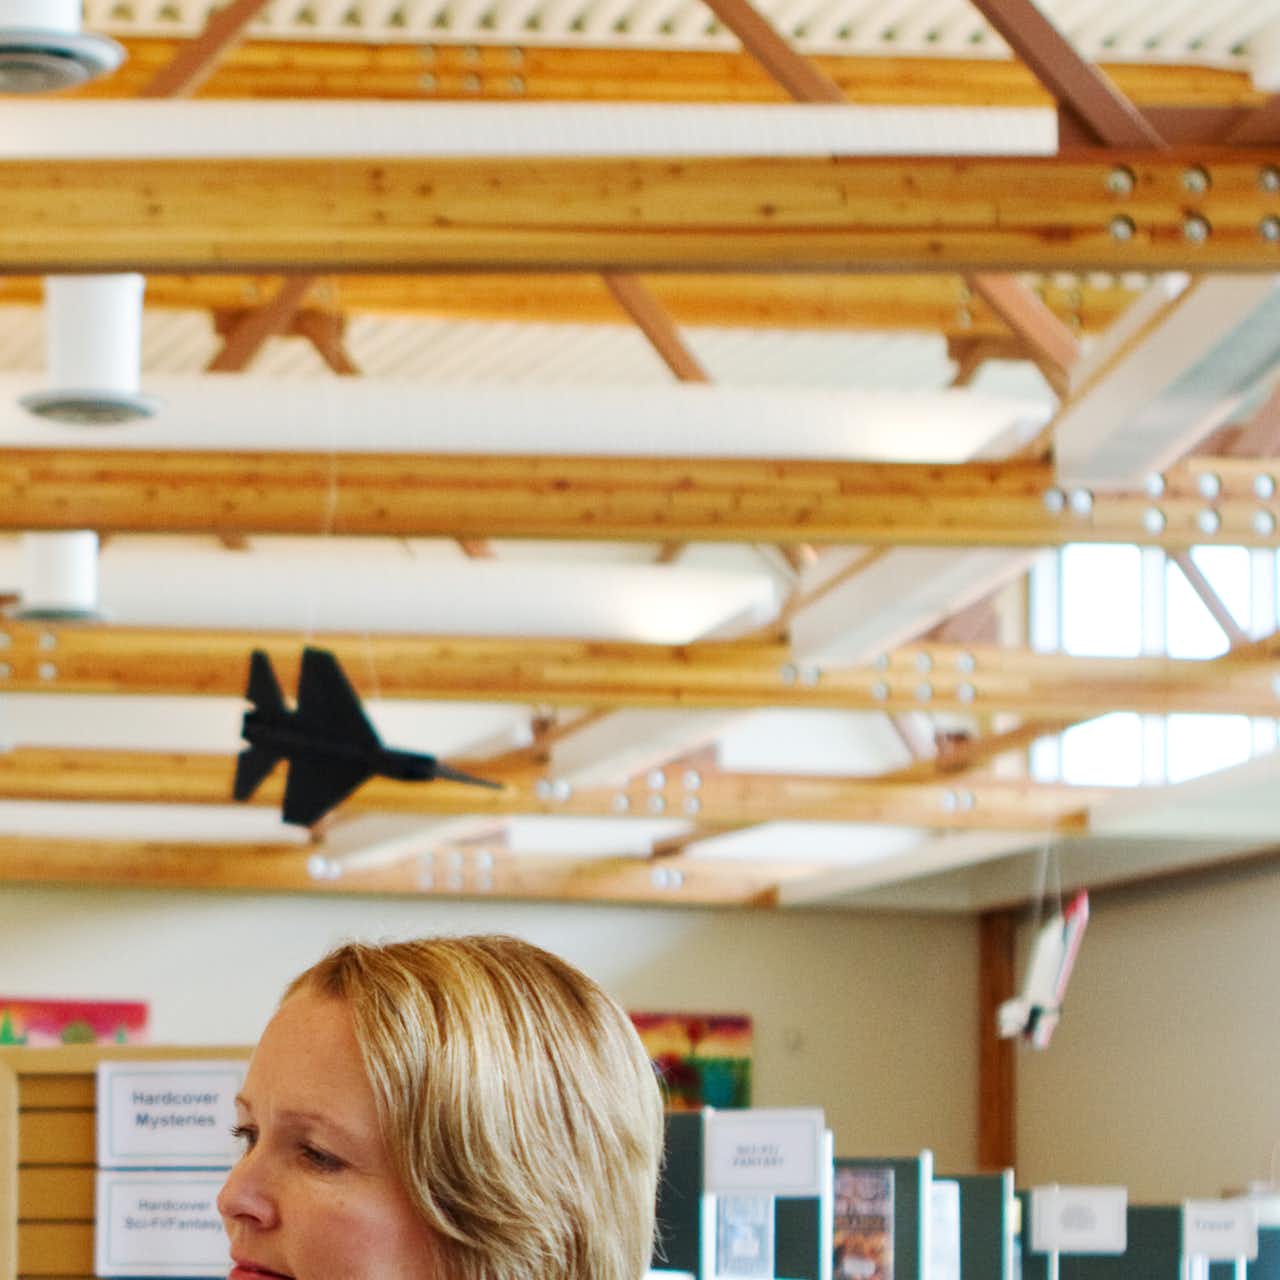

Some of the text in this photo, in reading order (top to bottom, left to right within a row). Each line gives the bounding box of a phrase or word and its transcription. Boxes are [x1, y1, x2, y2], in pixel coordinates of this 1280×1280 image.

[131, 1091, 220, 1106] Hardcover
[135, 1112, 217, 1130] Mysteries
[137, 1199, 211, 1211] Hardcover
